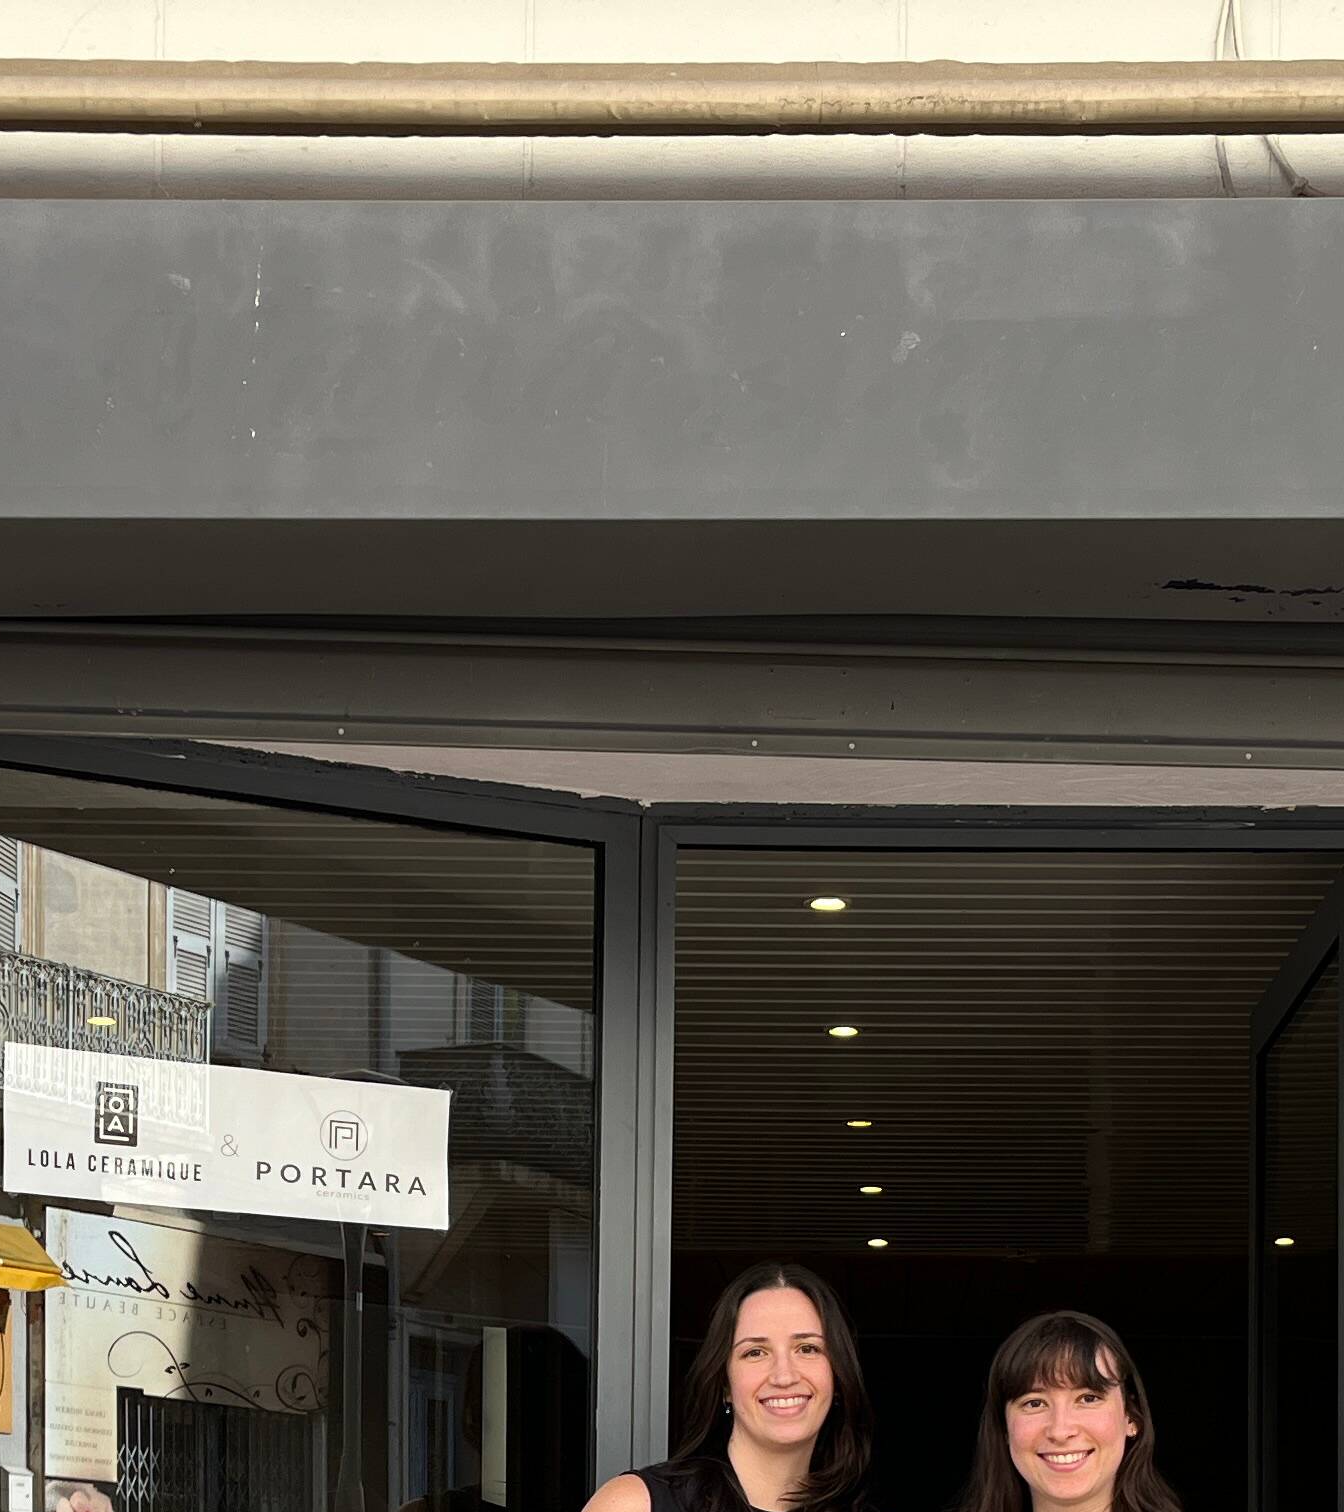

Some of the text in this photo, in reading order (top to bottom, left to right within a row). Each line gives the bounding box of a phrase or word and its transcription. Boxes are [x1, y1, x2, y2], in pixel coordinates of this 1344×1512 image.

[28, 1134, 426, 1196] LOLA CERAMIQUE & PORTARA
[316, 1190, 369, 1200] ceramics
